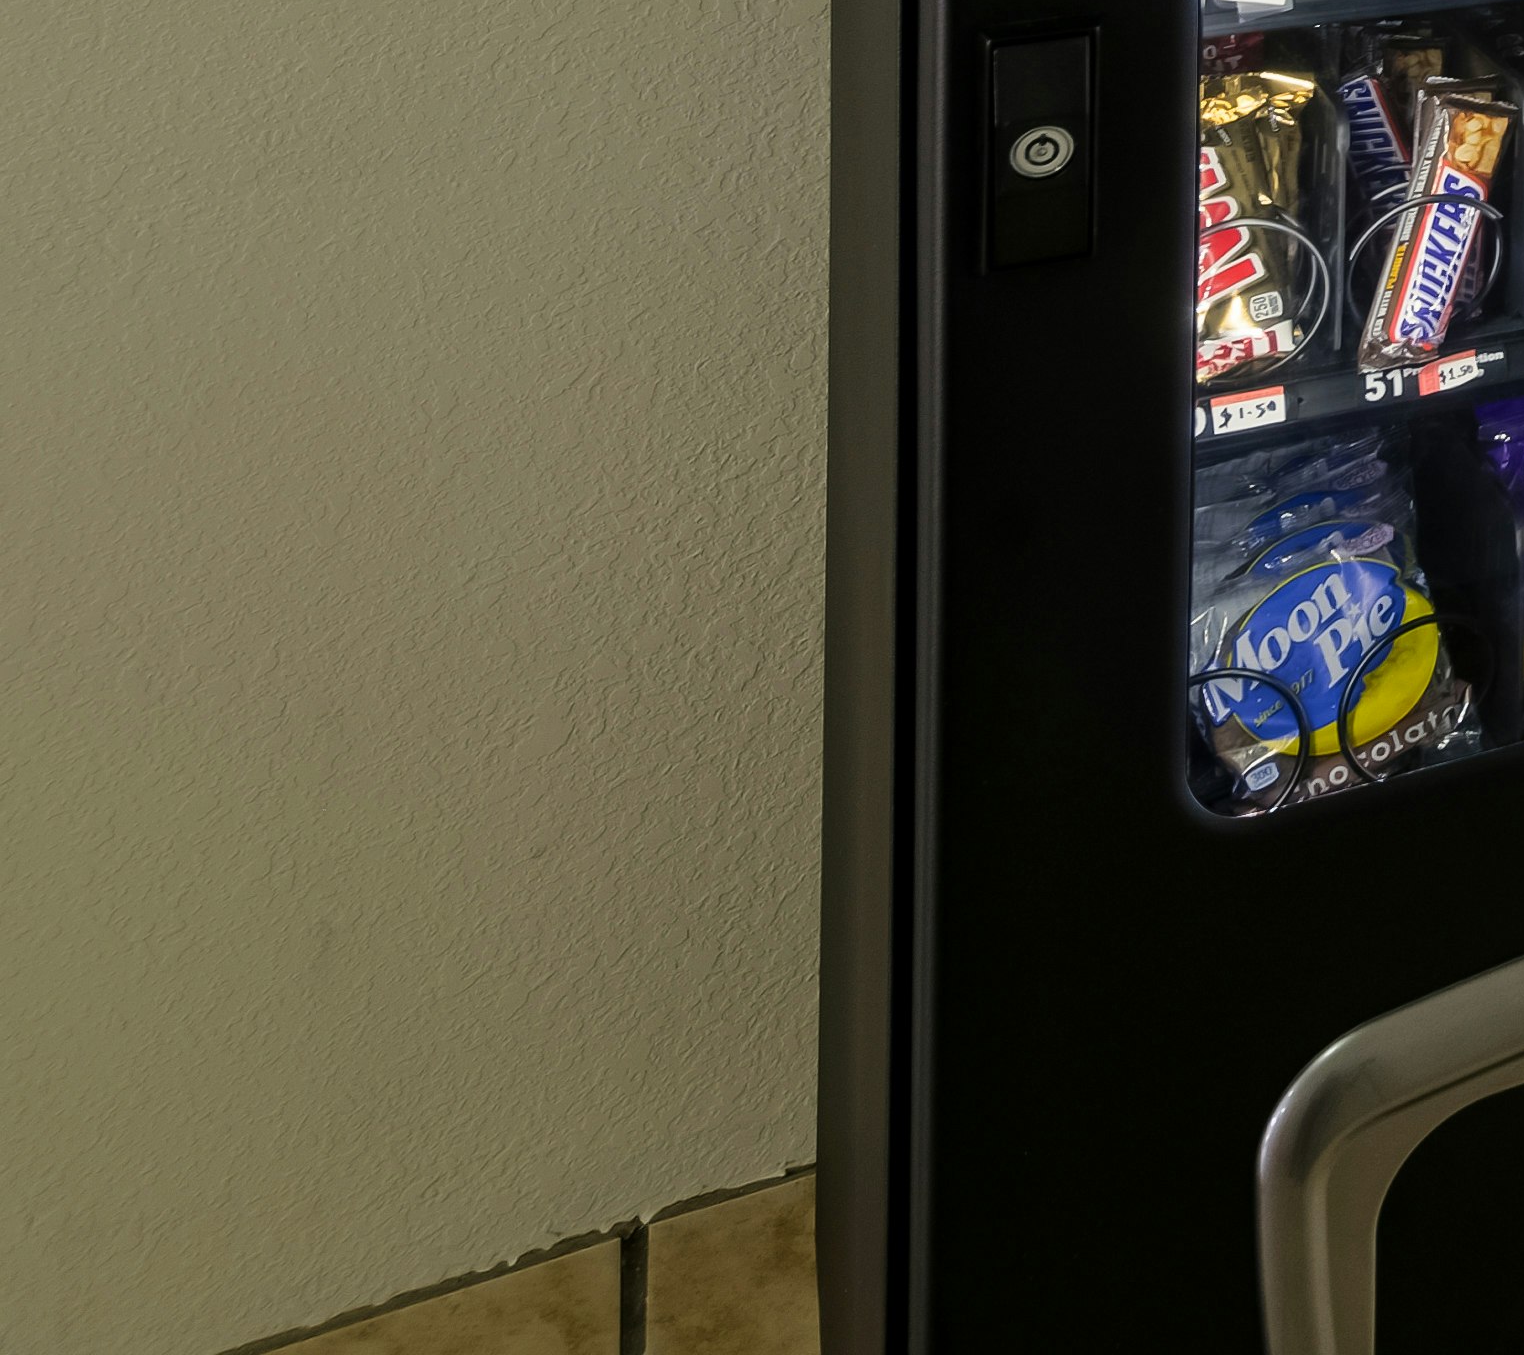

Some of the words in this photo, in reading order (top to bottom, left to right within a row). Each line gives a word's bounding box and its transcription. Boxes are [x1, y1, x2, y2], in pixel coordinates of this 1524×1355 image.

[1254, 295, 1268, 320] 250
[1365, 369, 1405, 402] 51
[1203, 572, 1352, 725] Moon
[1312, 594, 1396, 690] Pie
[1252, 700, 1285, 728] since
